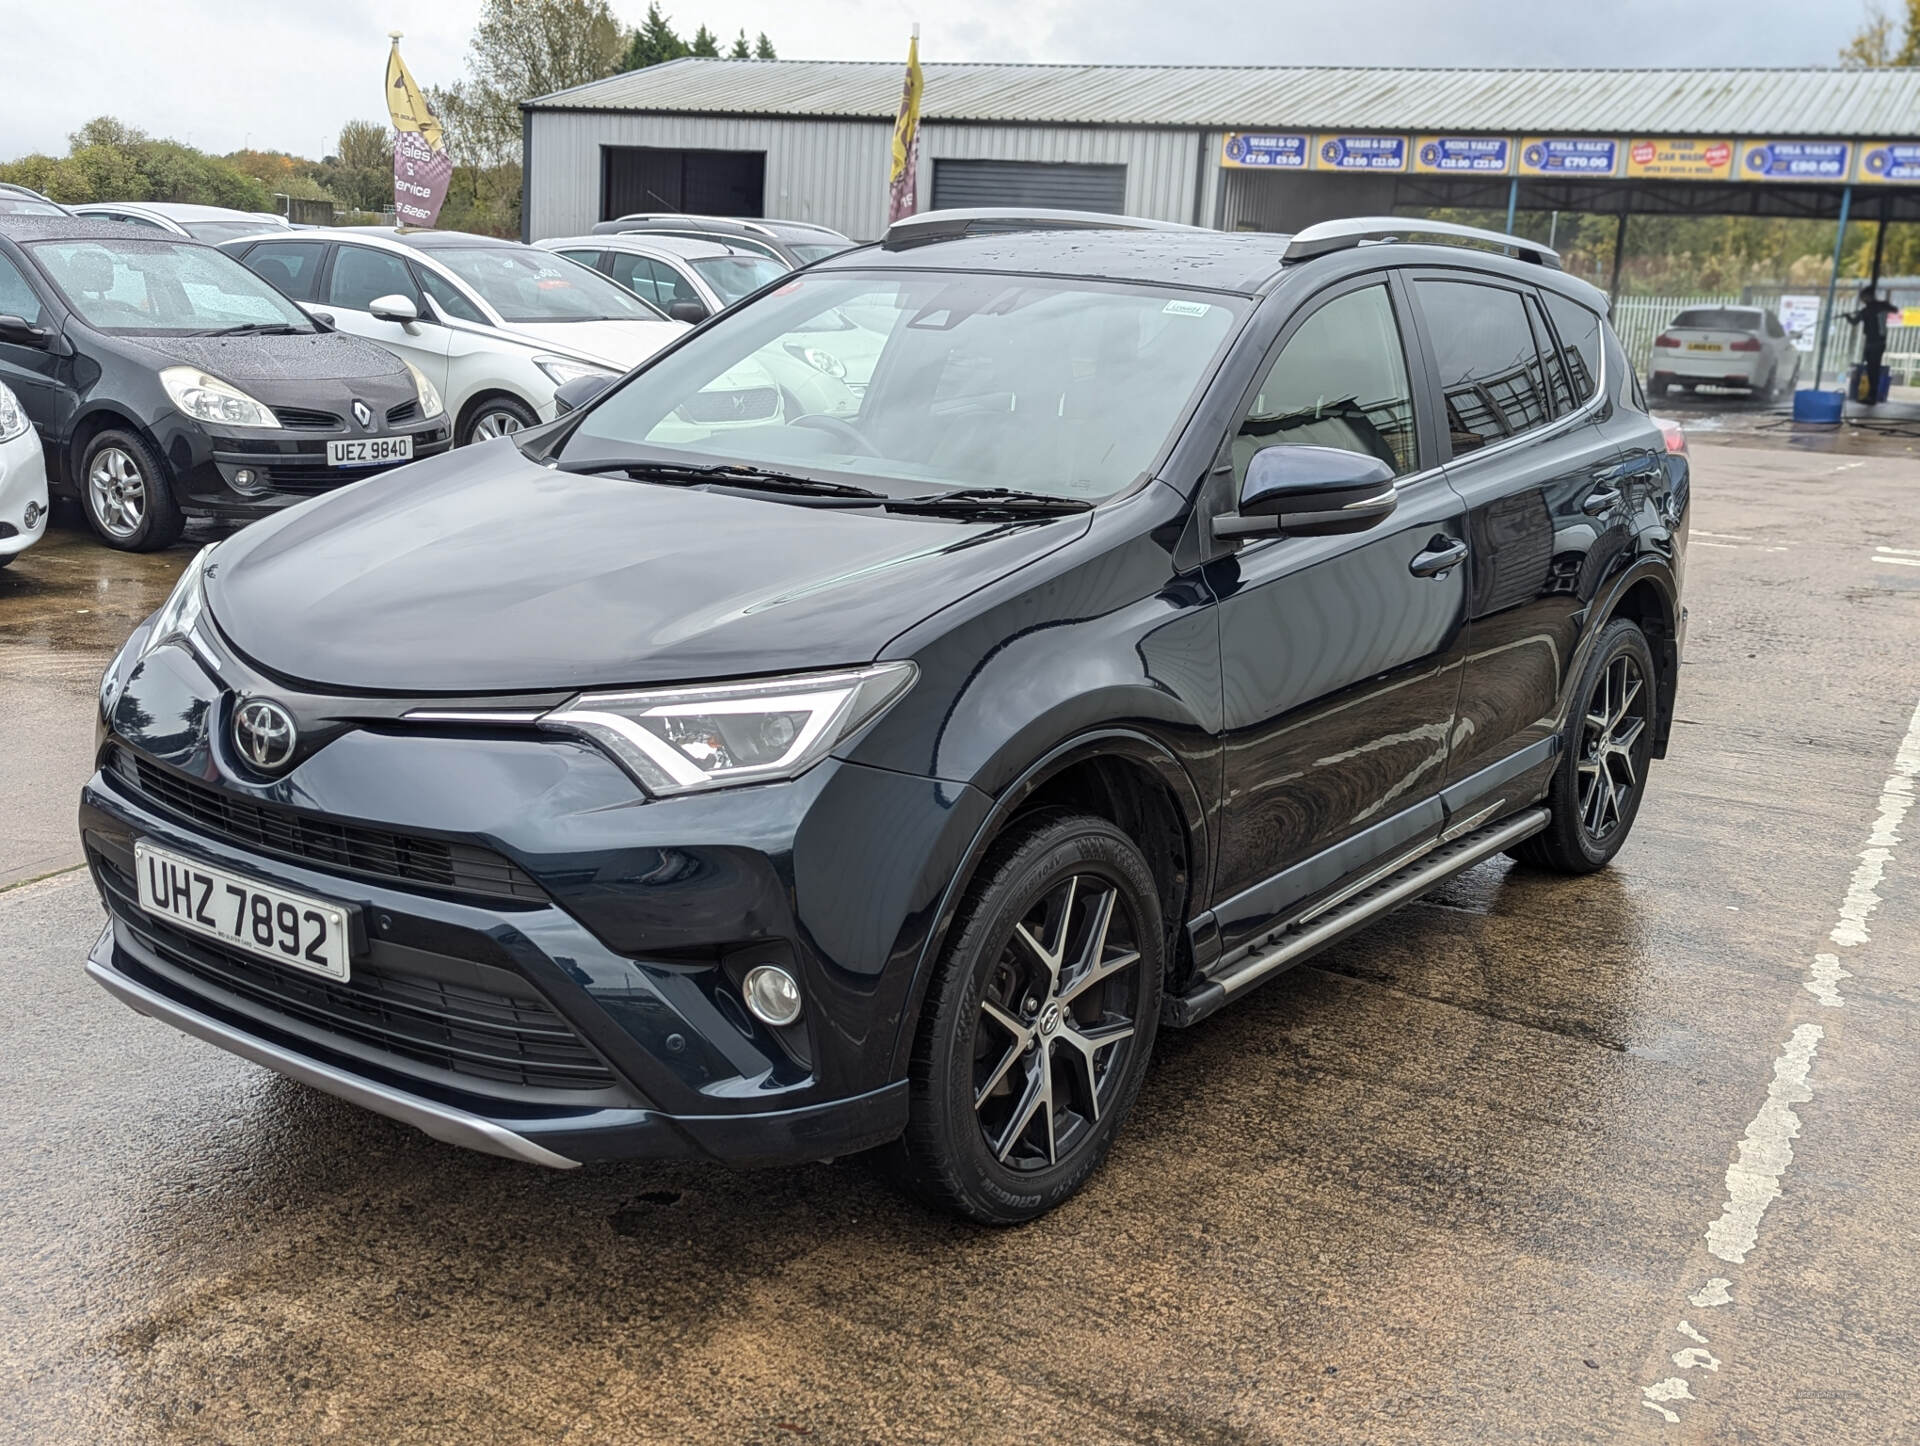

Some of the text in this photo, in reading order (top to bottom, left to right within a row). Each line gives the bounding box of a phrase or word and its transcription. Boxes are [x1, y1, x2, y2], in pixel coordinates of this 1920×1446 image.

[1250, 138, 1300, 147] WASH & GO
[1471, 141, 1501, 150] VALET
[1577, 142, 1612, 152] VALET
[401, 144, 431, 163] ales
[1658, 152, 1676, 161] CAR
[395, 175, 431, 198] ervice
[335, 439, 407, 462] UEZ 9840
[149, 856, 329, 967] UHZ 7892
